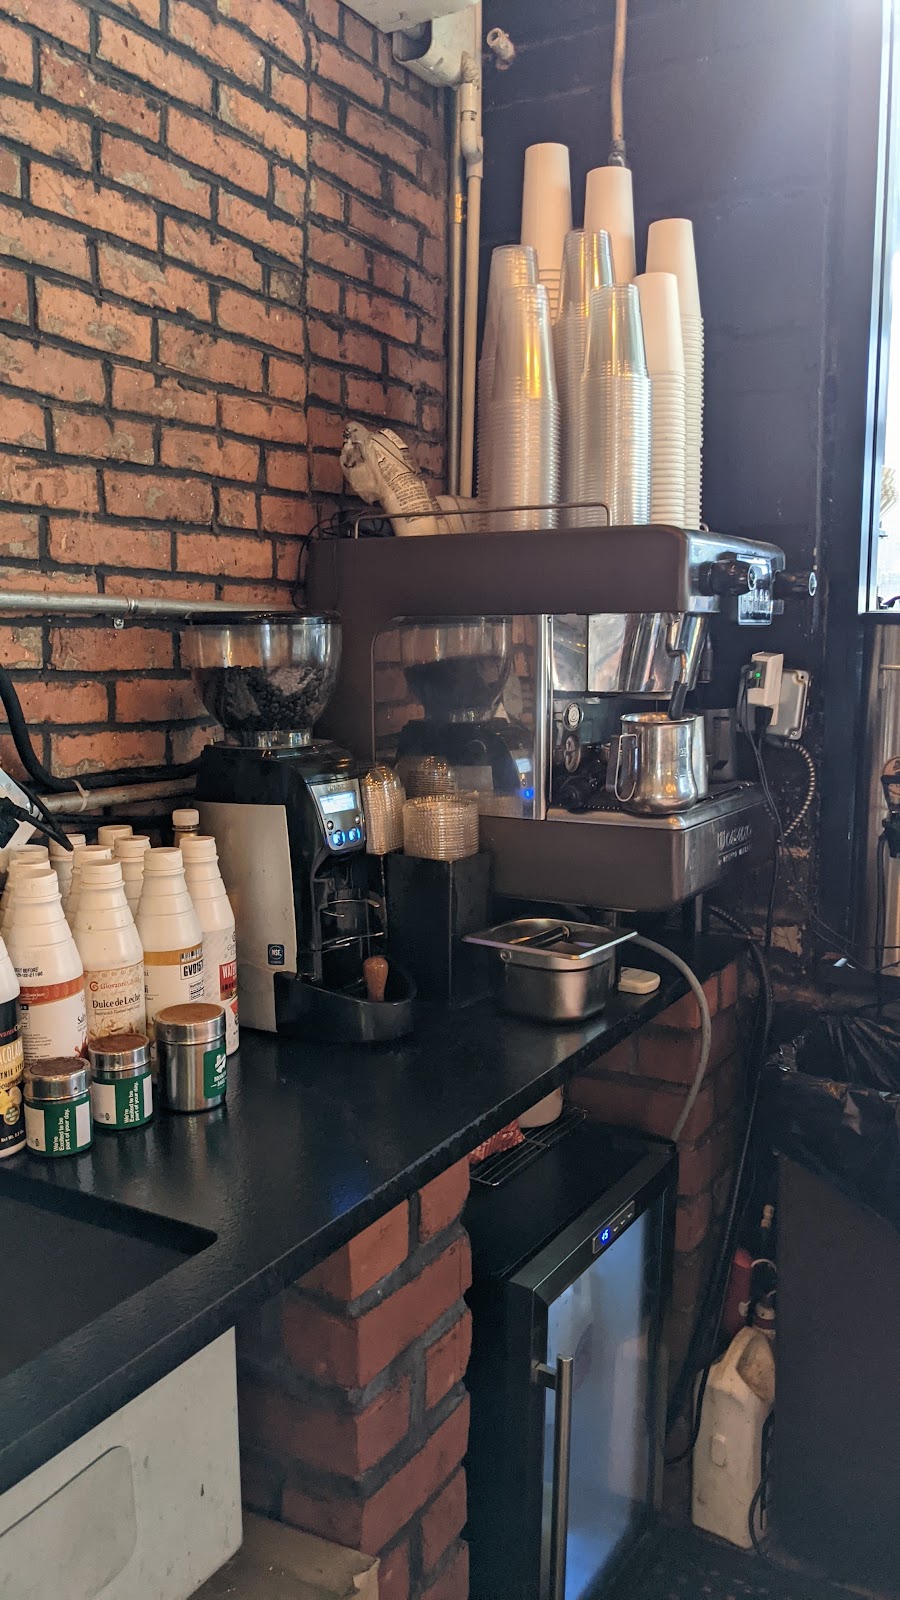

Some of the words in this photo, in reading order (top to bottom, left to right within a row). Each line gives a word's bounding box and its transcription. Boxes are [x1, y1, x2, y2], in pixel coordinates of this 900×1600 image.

[92, 1000, 113, 1009] Dulce
[115, 998, 123, 1007] de
[124, 993, 140, 1005] Leche
